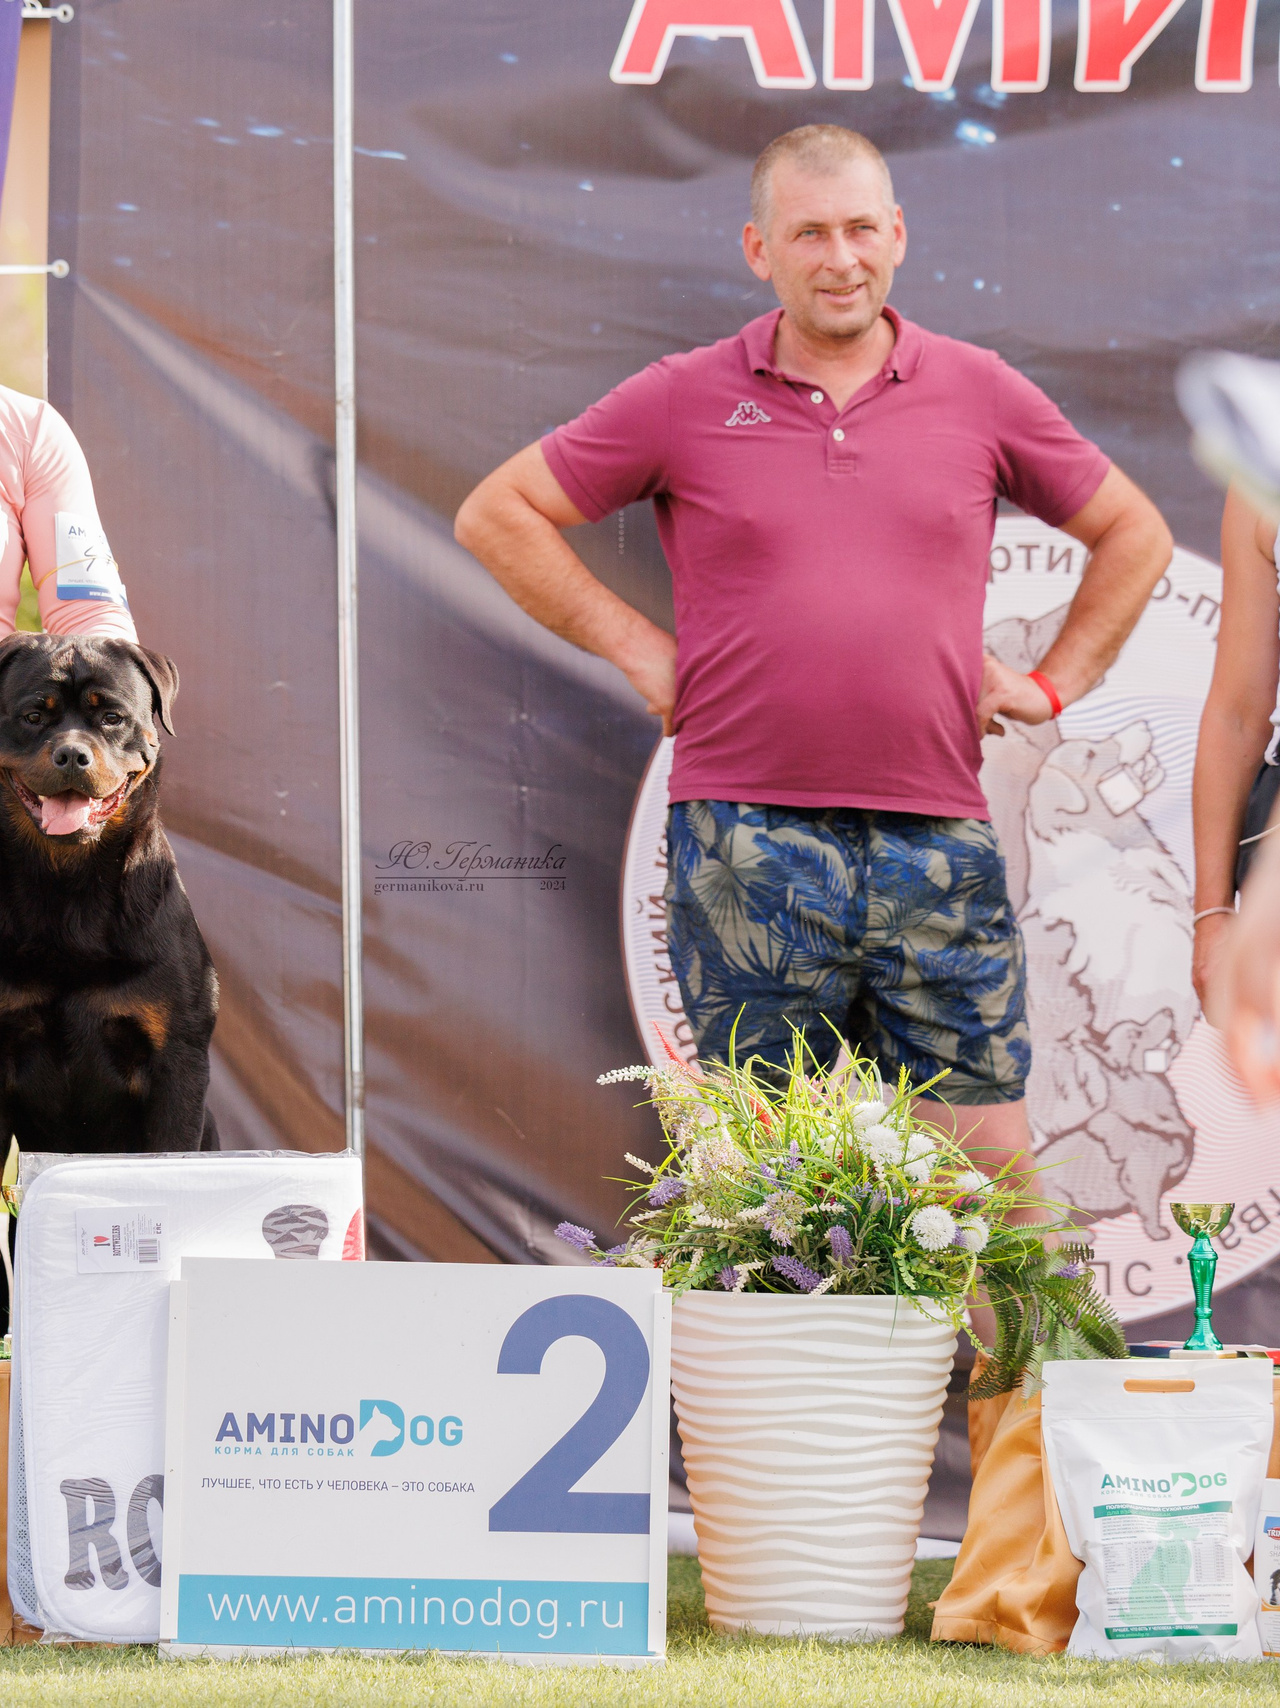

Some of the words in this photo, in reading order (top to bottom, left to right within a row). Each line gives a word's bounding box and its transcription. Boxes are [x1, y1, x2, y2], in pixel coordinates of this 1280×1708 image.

[609, 0, 1280, 93] АМИ
[488, 1293, 651, 1535] 2
[214, 1446, 262, 1455] КОРМА
[270, 1447, 299, 1457] ДЛЯ
[307, 1447, 355, 1457] СОБАК
[201, 1477, 255, 1490] ЛУЧШЕЕ,
[258, 1478, 281, 1490] ЧТО
[284, 1479, 313, 1490] ЕСТЬ
[316, 1480, 325, 1490] У
[327, 1480, 389, 1491] ЧЕЛОВЕКА
[401, 1481, 425, 1492] ЭТО
[427, 1481, 475, 1493] СОБАКА
[207, 1584, 624, 1640] www.aminodog.ru
